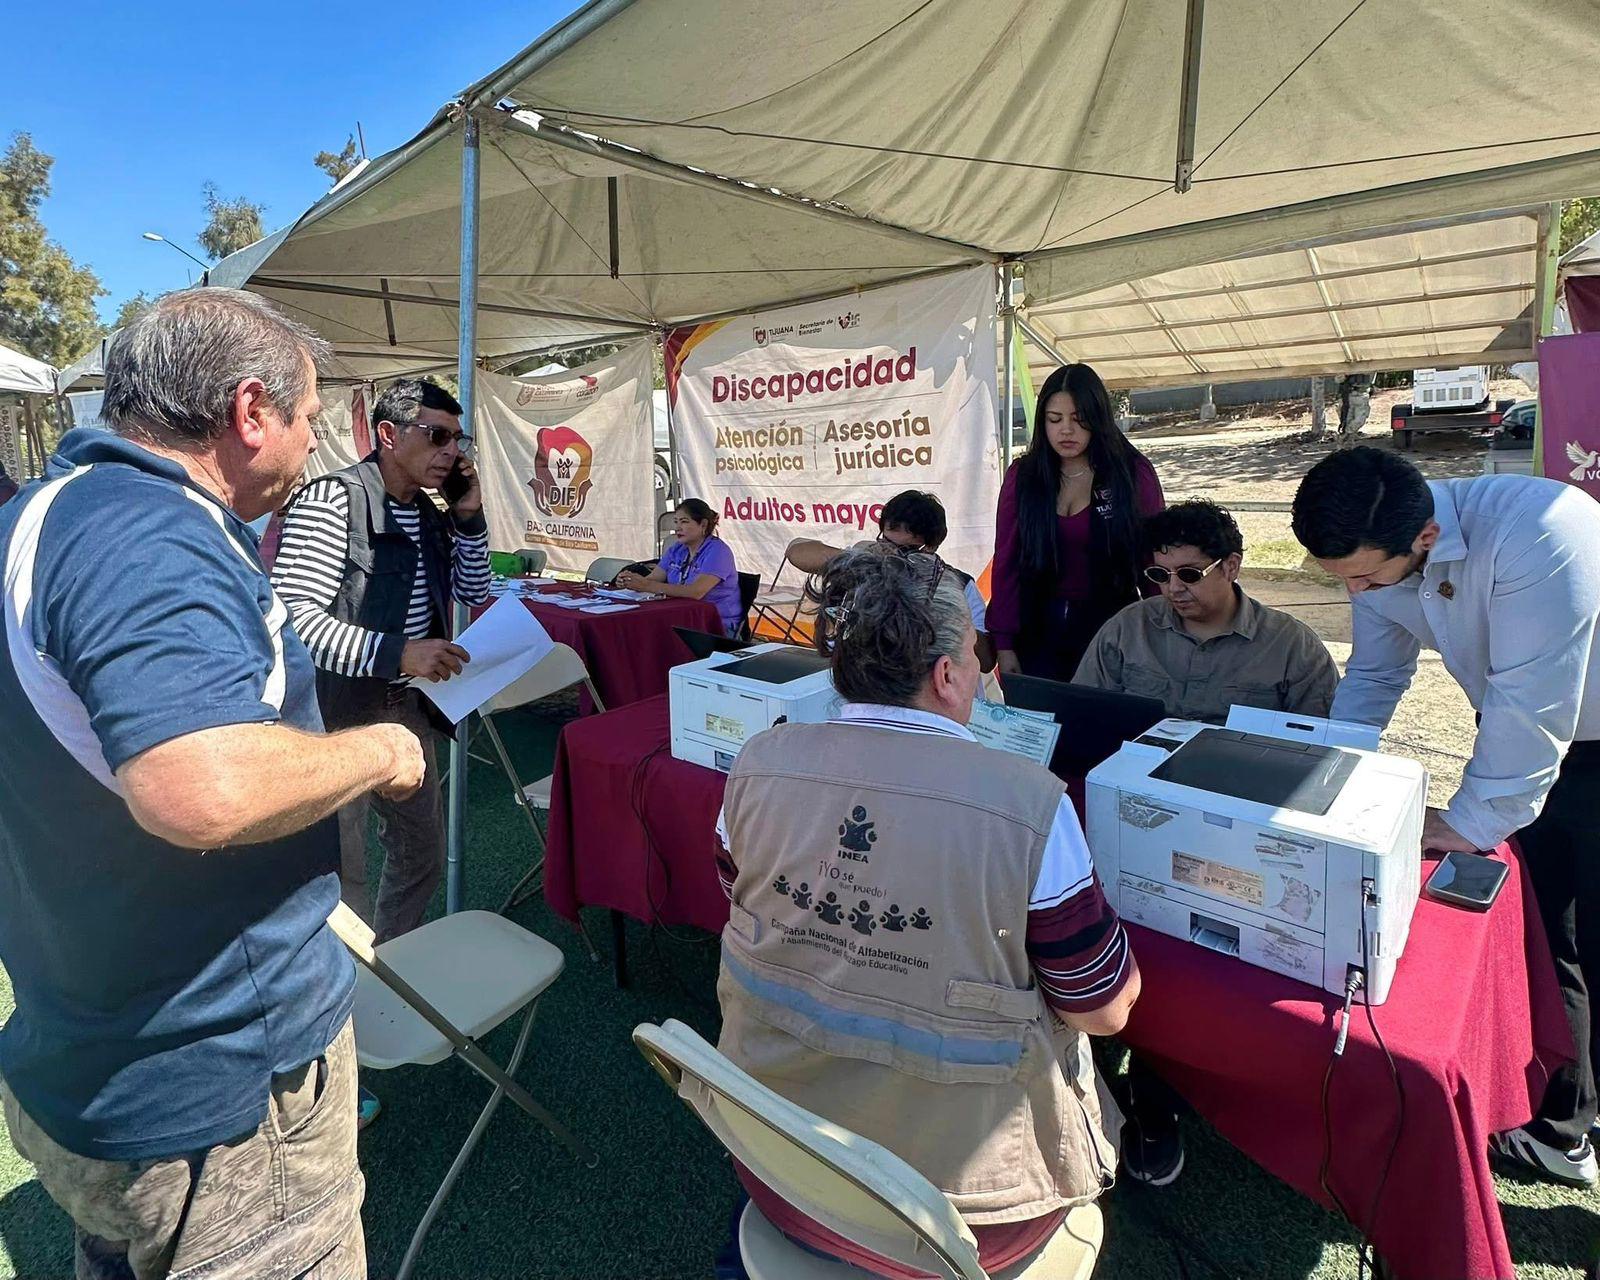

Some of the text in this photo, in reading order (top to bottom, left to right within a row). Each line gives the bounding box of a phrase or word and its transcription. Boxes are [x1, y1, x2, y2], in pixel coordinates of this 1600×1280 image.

[769, 326, 794, 336] TIJUANA
[712, 346, 917, 403] Discapacidad
[715, 419, 803, 449] Atención
[823, 409, 931, 443] Asesoría
[715, 450, 804, 476] psicológica
[835, 443, 933, 475] jurídica
[549, 487, 576, 506] DIF
[723, 496, 885, 530] Adultos mayo
[545, 523, 597, 539] CALIFORNIA
[837, 850, 869, 864] INEA
[853, 884, 887, 898] puedo!
[786, 937, 831, 952] Abatimiento
[868, 959, 908, 975] Educativo
[808, 928, 847, 948] Nacional
[857, 946, 929, 970] Alfabetización
